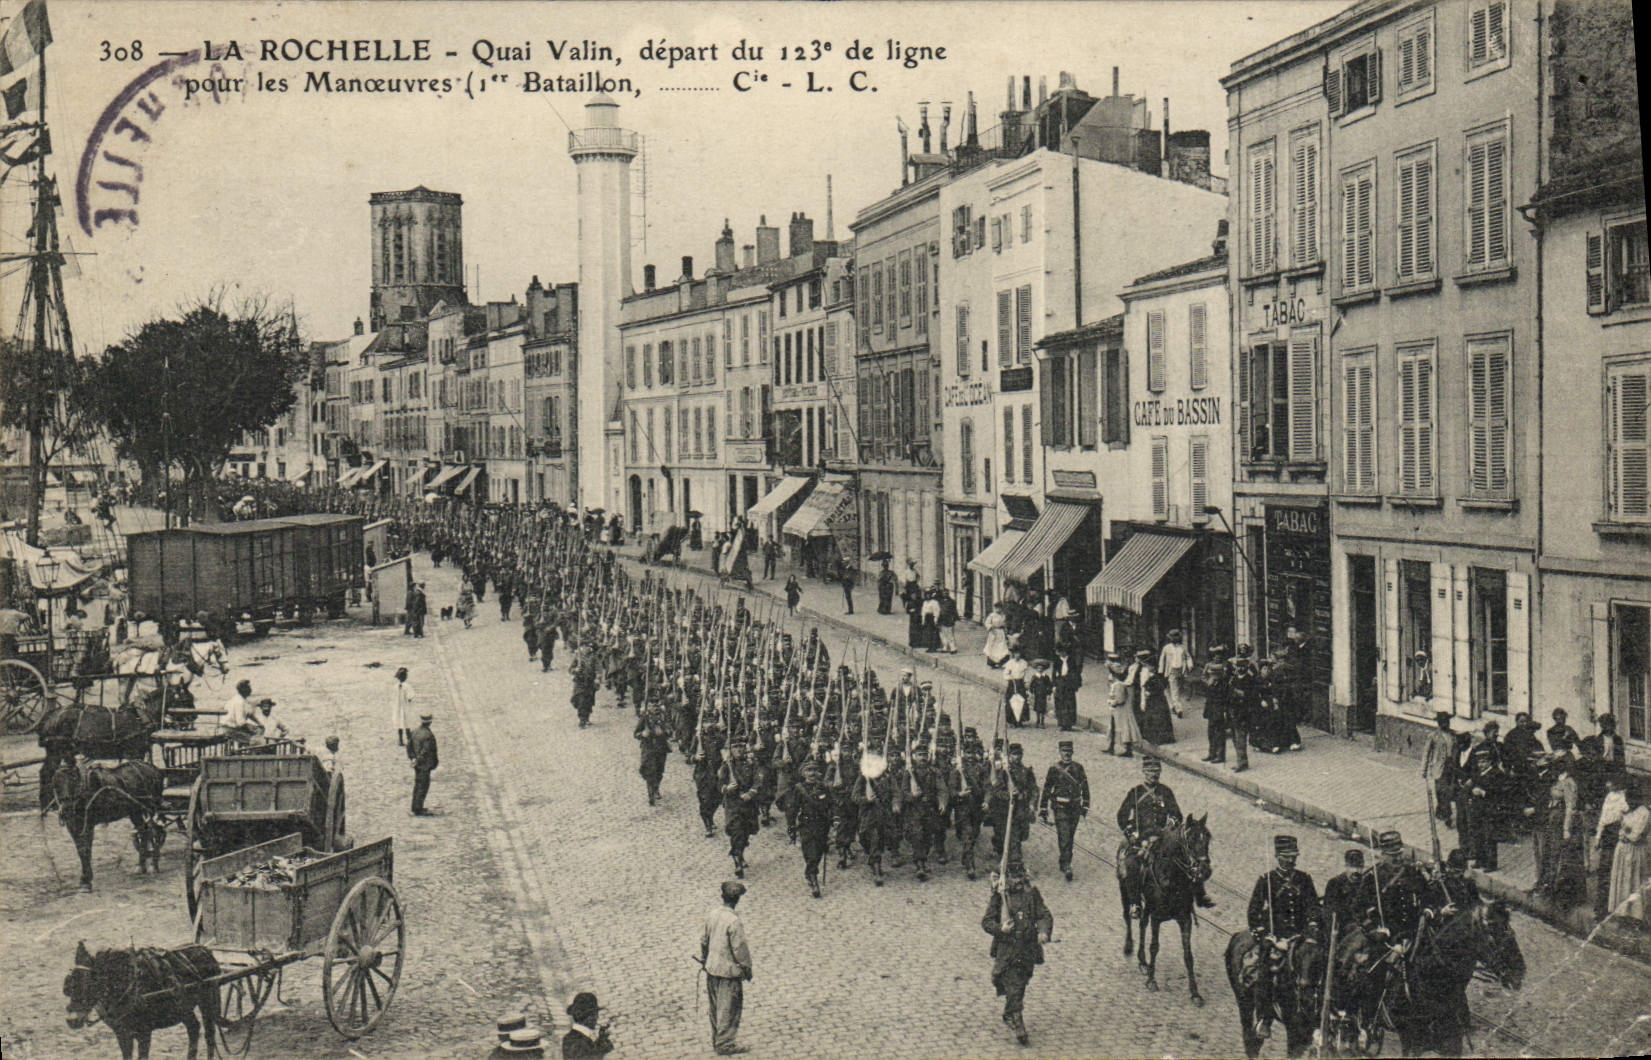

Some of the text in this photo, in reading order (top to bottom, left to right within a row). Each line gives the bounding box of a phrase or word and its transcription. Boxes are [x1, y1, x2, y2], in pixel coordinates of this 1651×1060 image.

[1263, 298, 1306, 328] TABAC
[1163, 407, 1174, 426] DU
[1176, 397, 1221, 426] BASSIN
[1274, 510, 1317, 534] TABAC
